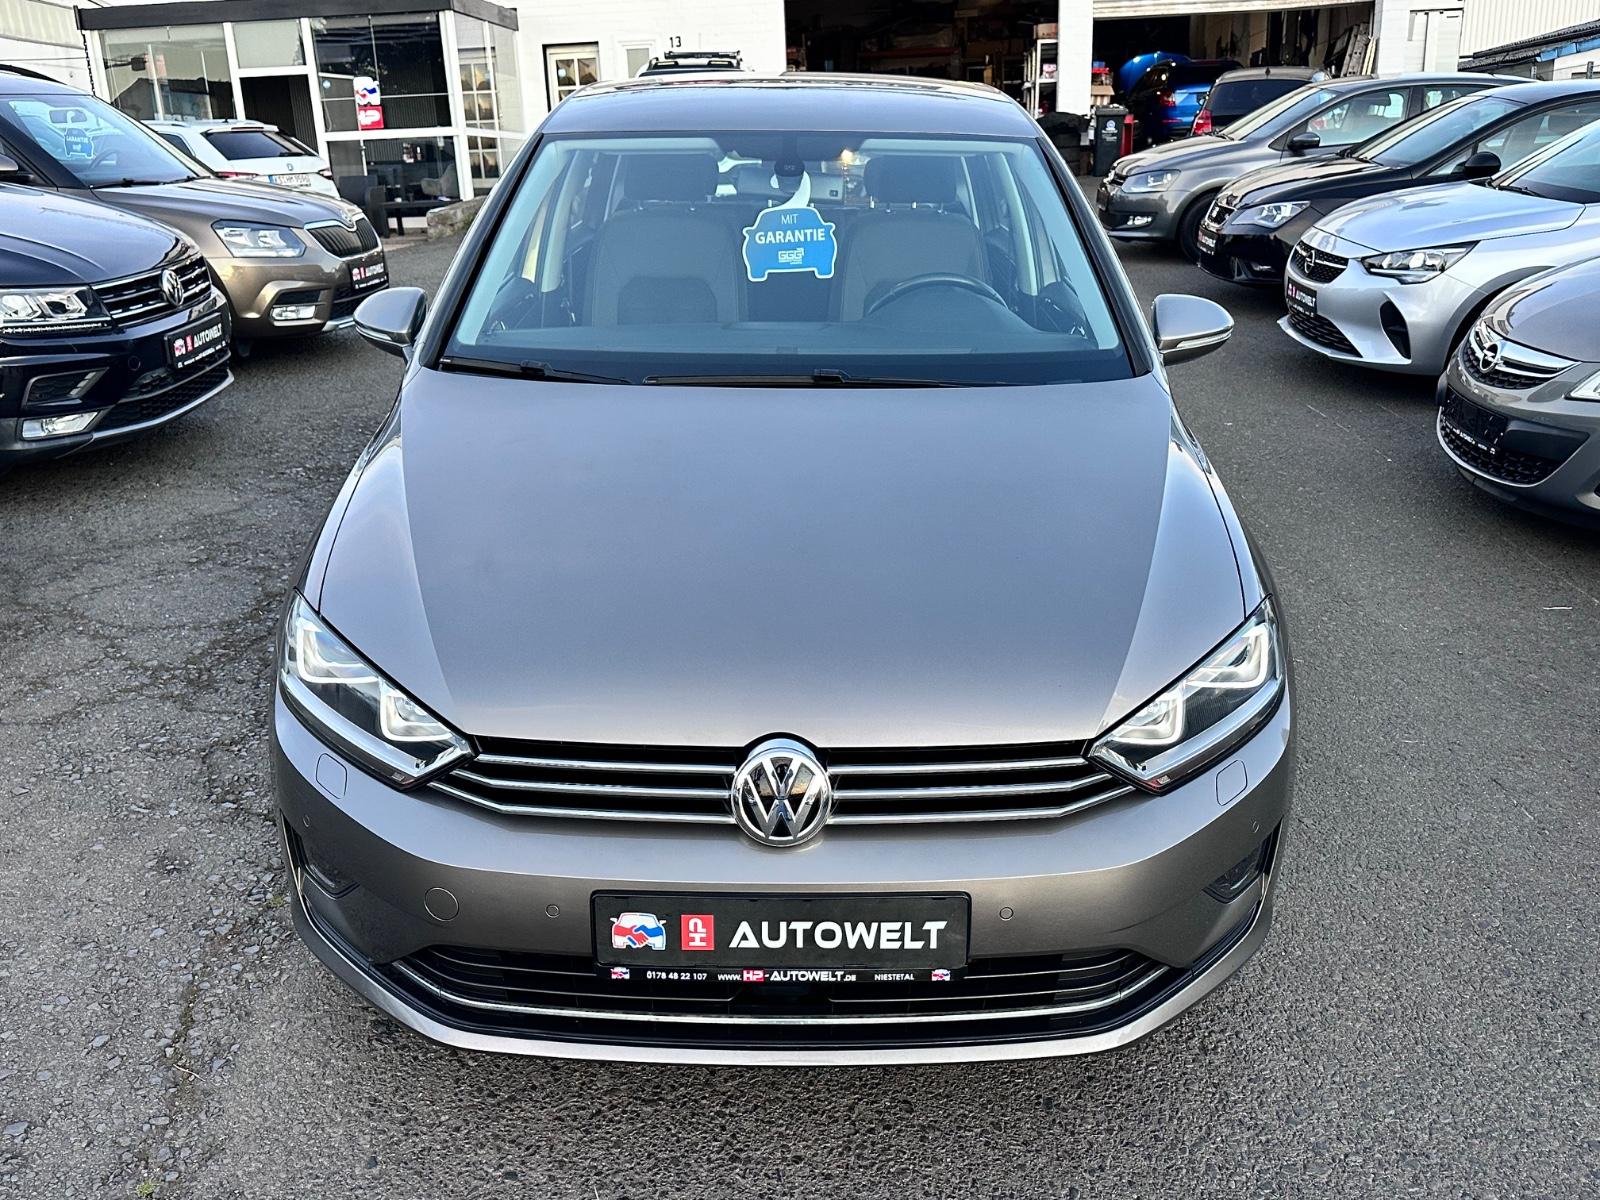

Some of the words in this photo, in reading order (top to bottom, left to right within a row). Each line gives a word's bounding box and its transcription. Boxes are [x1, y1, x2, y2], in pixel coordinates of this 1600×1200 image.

[669, 35, 682, 48] 13
[781, 213, 800, 225] MIT
[755, 228, 826, 244] GARANTIE
[778, 247, 805, 260] GGG
[688, 917, 707, 947] HP
[728, 920, 948, 950] AUTOWELT
[646, 970, 667, 980] 0178
[668, 970, 678, 980] 48
[680, 970, 691, 980] 22
[693, 971, 708, 981] 107
[874, 973, 915, 981] NIESTETAL
